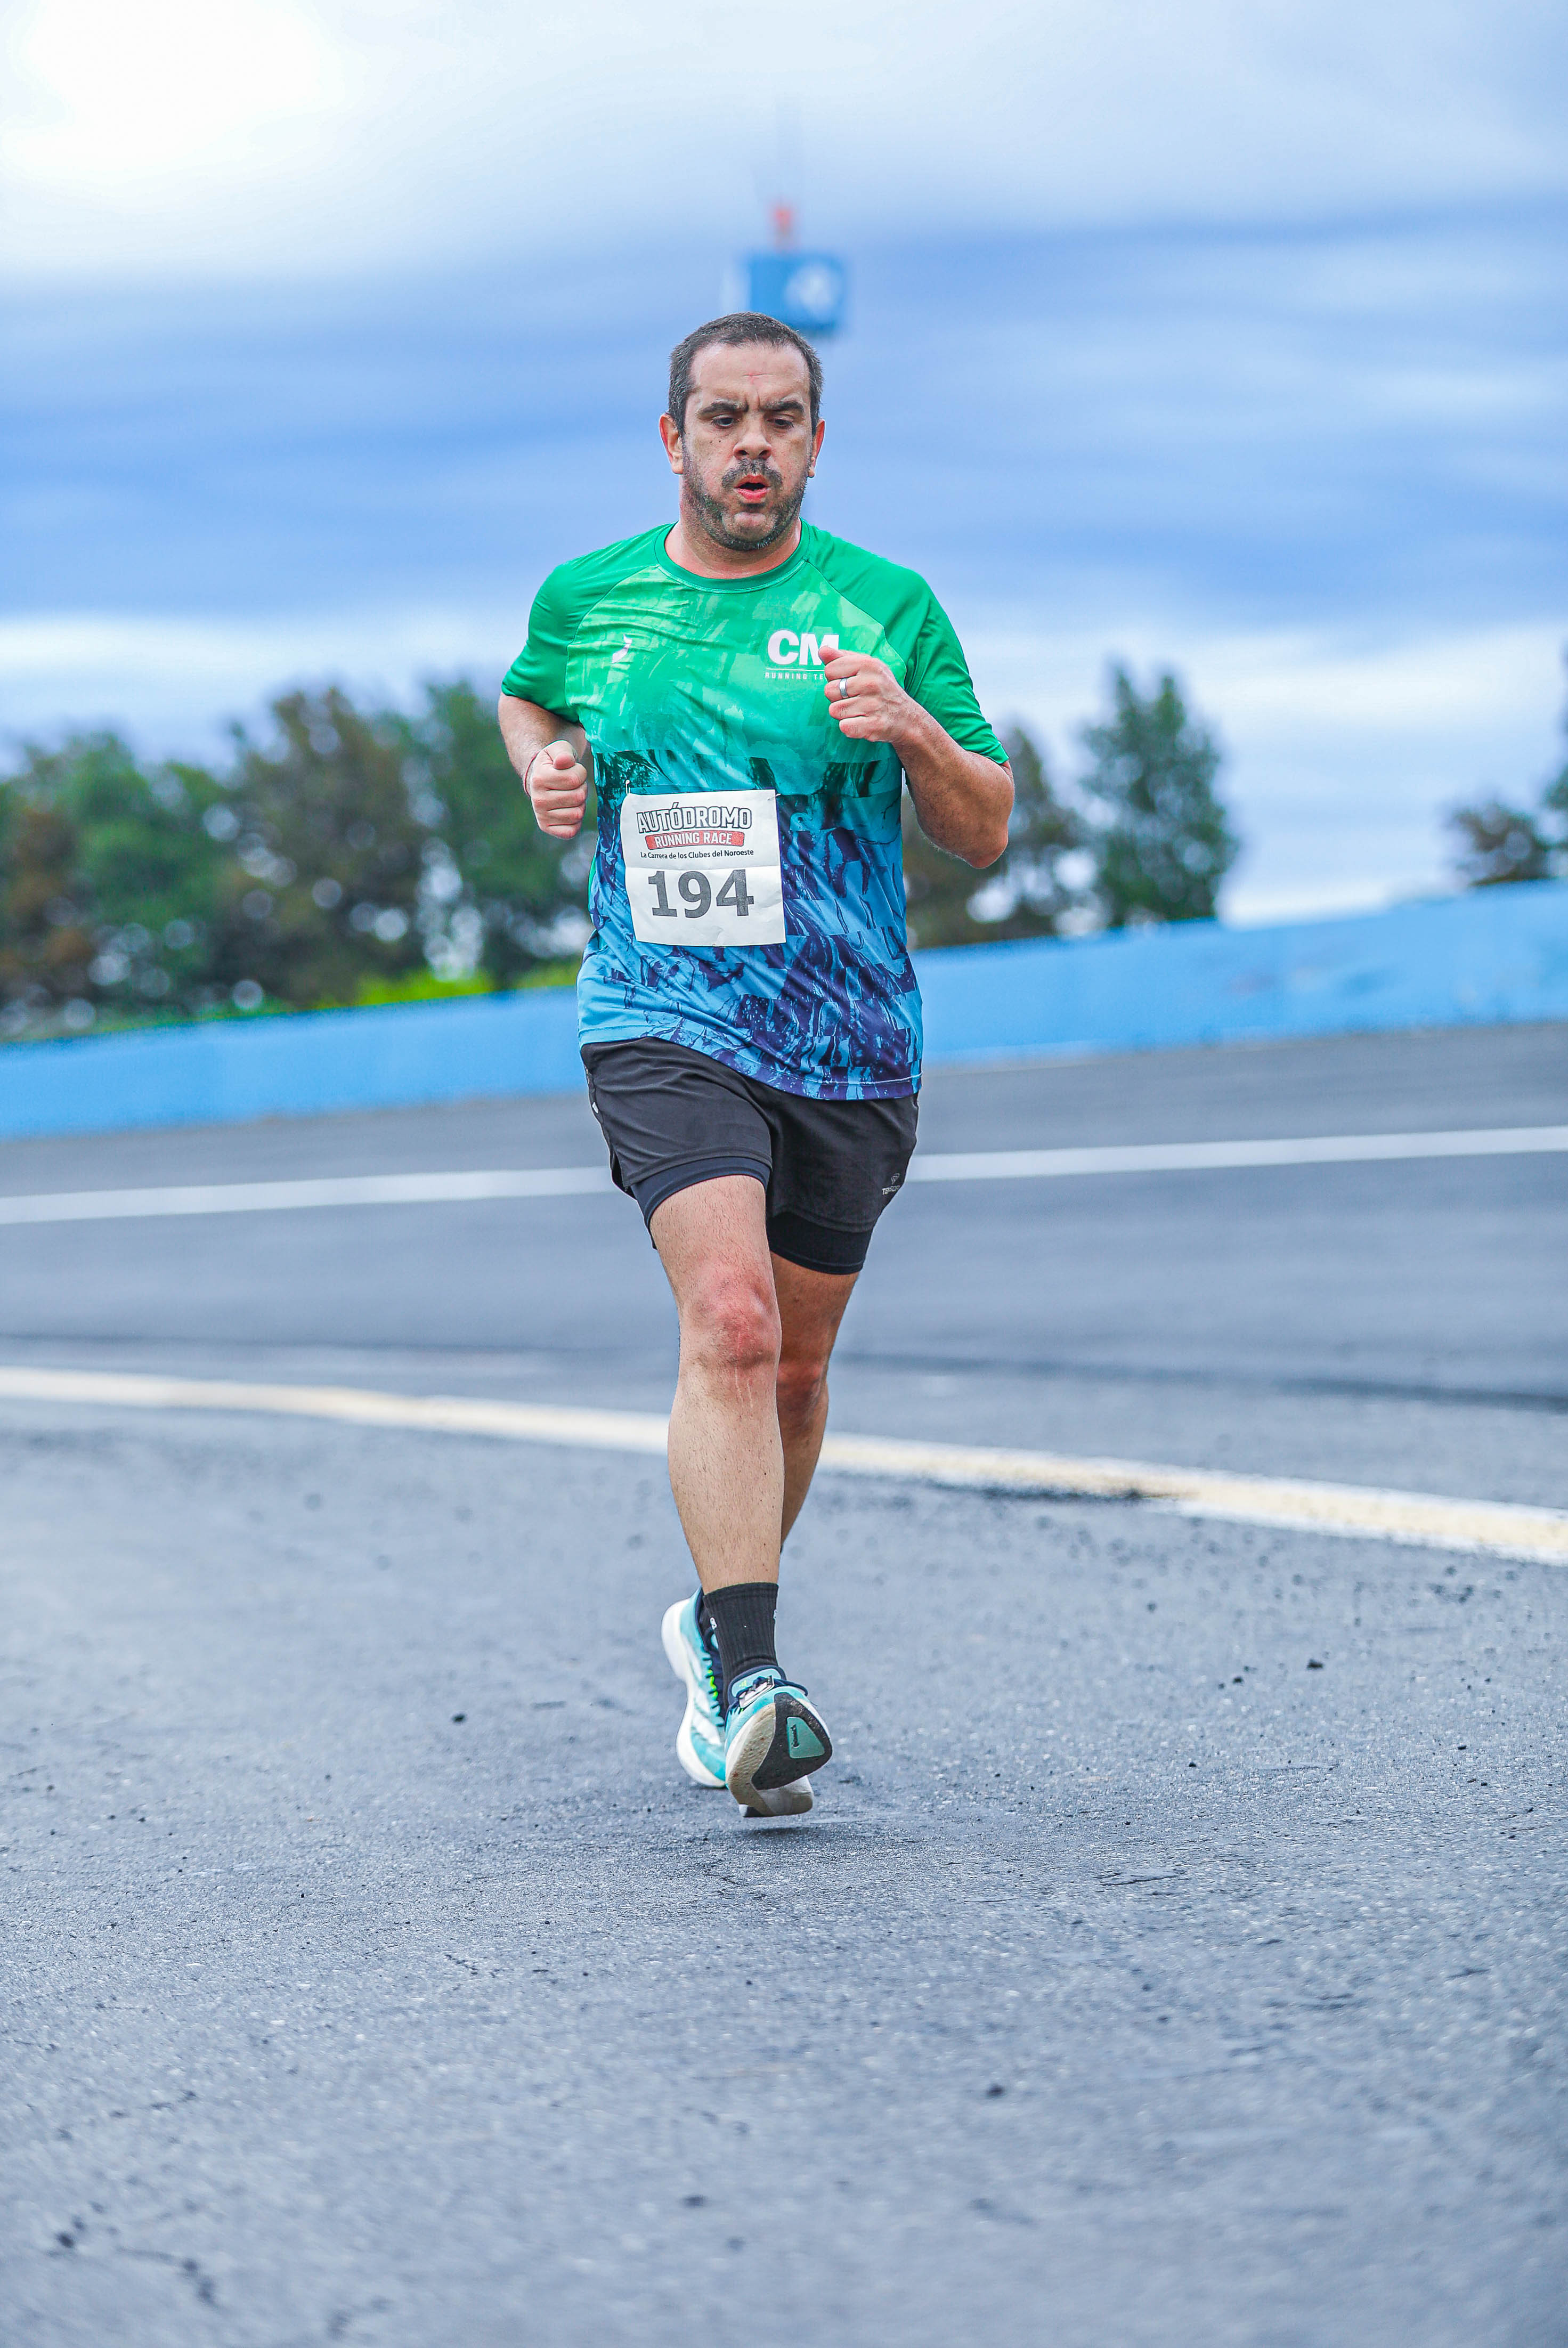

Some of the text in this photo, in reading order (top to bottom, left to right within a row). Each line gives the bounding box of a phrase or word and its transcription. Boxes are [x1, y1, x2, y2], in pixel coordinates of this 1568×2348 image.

[768, 630, 840, 665] CM
[636, 802, 752, 834] AUTÓDROMO
[654, 832, 733, 848] RUNNING RACE
[648, 869, 754, 919] 194
